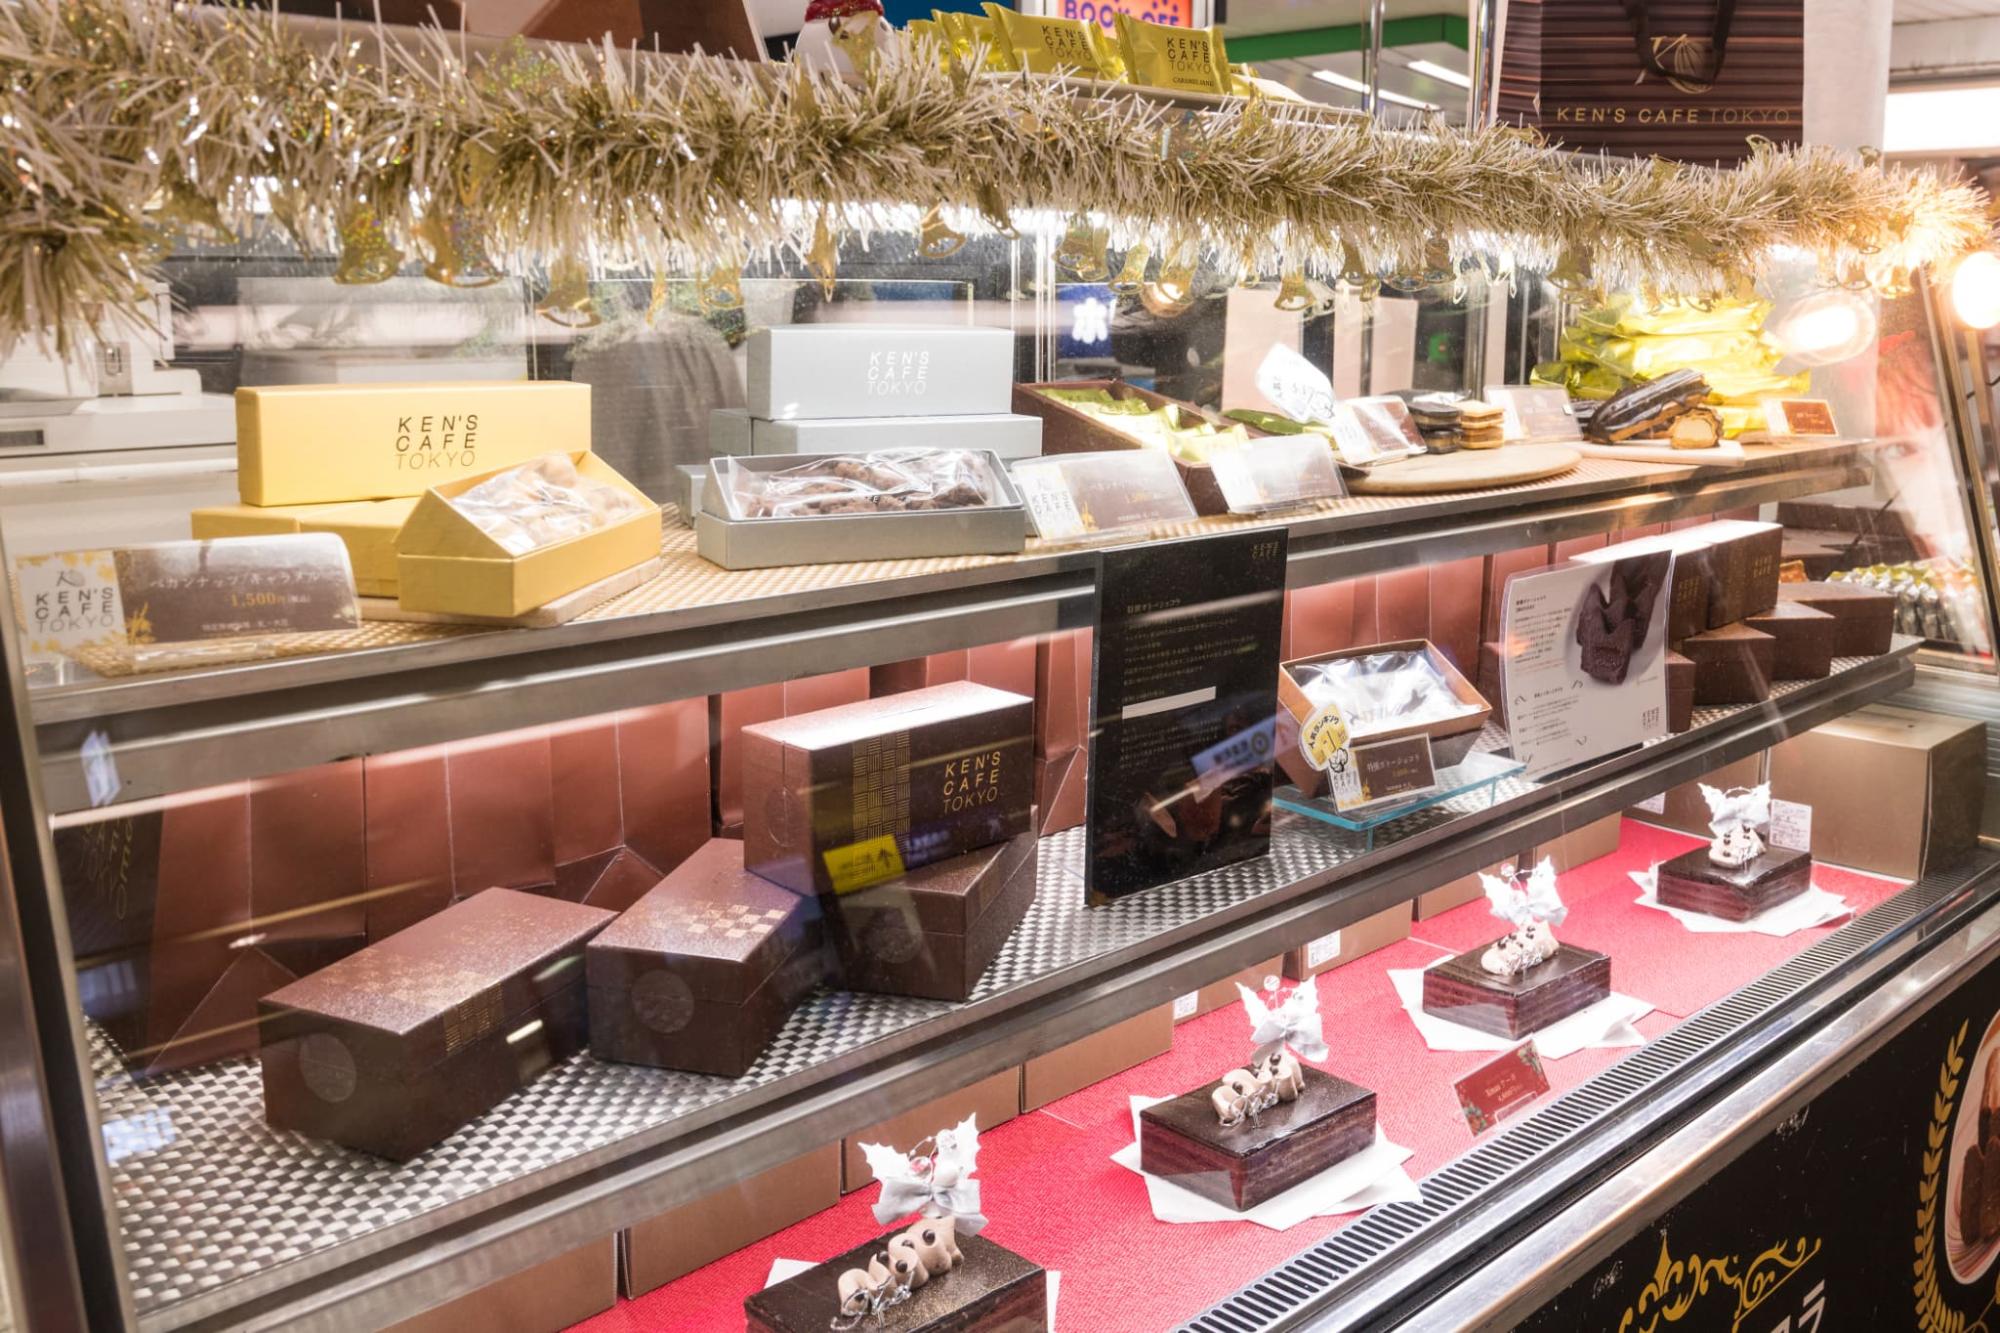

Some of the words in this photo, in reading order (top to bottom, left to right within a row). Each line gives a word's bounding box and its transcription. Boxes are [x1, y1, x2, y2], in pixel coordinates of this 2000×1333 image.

[1044, 36, 1089, 50] CAFE
[1167, 37, 1209, 51] KEN'S
[1168, 49, 1210, 63] CAFE
[1169, 60, 1211, 74] TOKYO
[1556, 107, 1626, 124] KEN'S
[1638, 107, 1699, 124] CAFE
[1709, 107, 1790, 124] TOKYO
[869, 351, 929, 365] KEN'S
[868, 366, 929, 380] CAFE
[866, 380, 927, 396] TOKYO
[398, 414, 478, 433] KEN'S
[395, 432, 477, 452] CAFE
[394, 450, 475, 470] TOKYO
[35, 586, 113, 607] KEN'S
[35, 600, 112, 620] CAFE
[35, 613, 114, 633] TOKYO
[944, 750, 1001, 778] KEN'S
[943, 769, 1000, 796] CAFE
[943, 787, 998, 815] TOKYO
